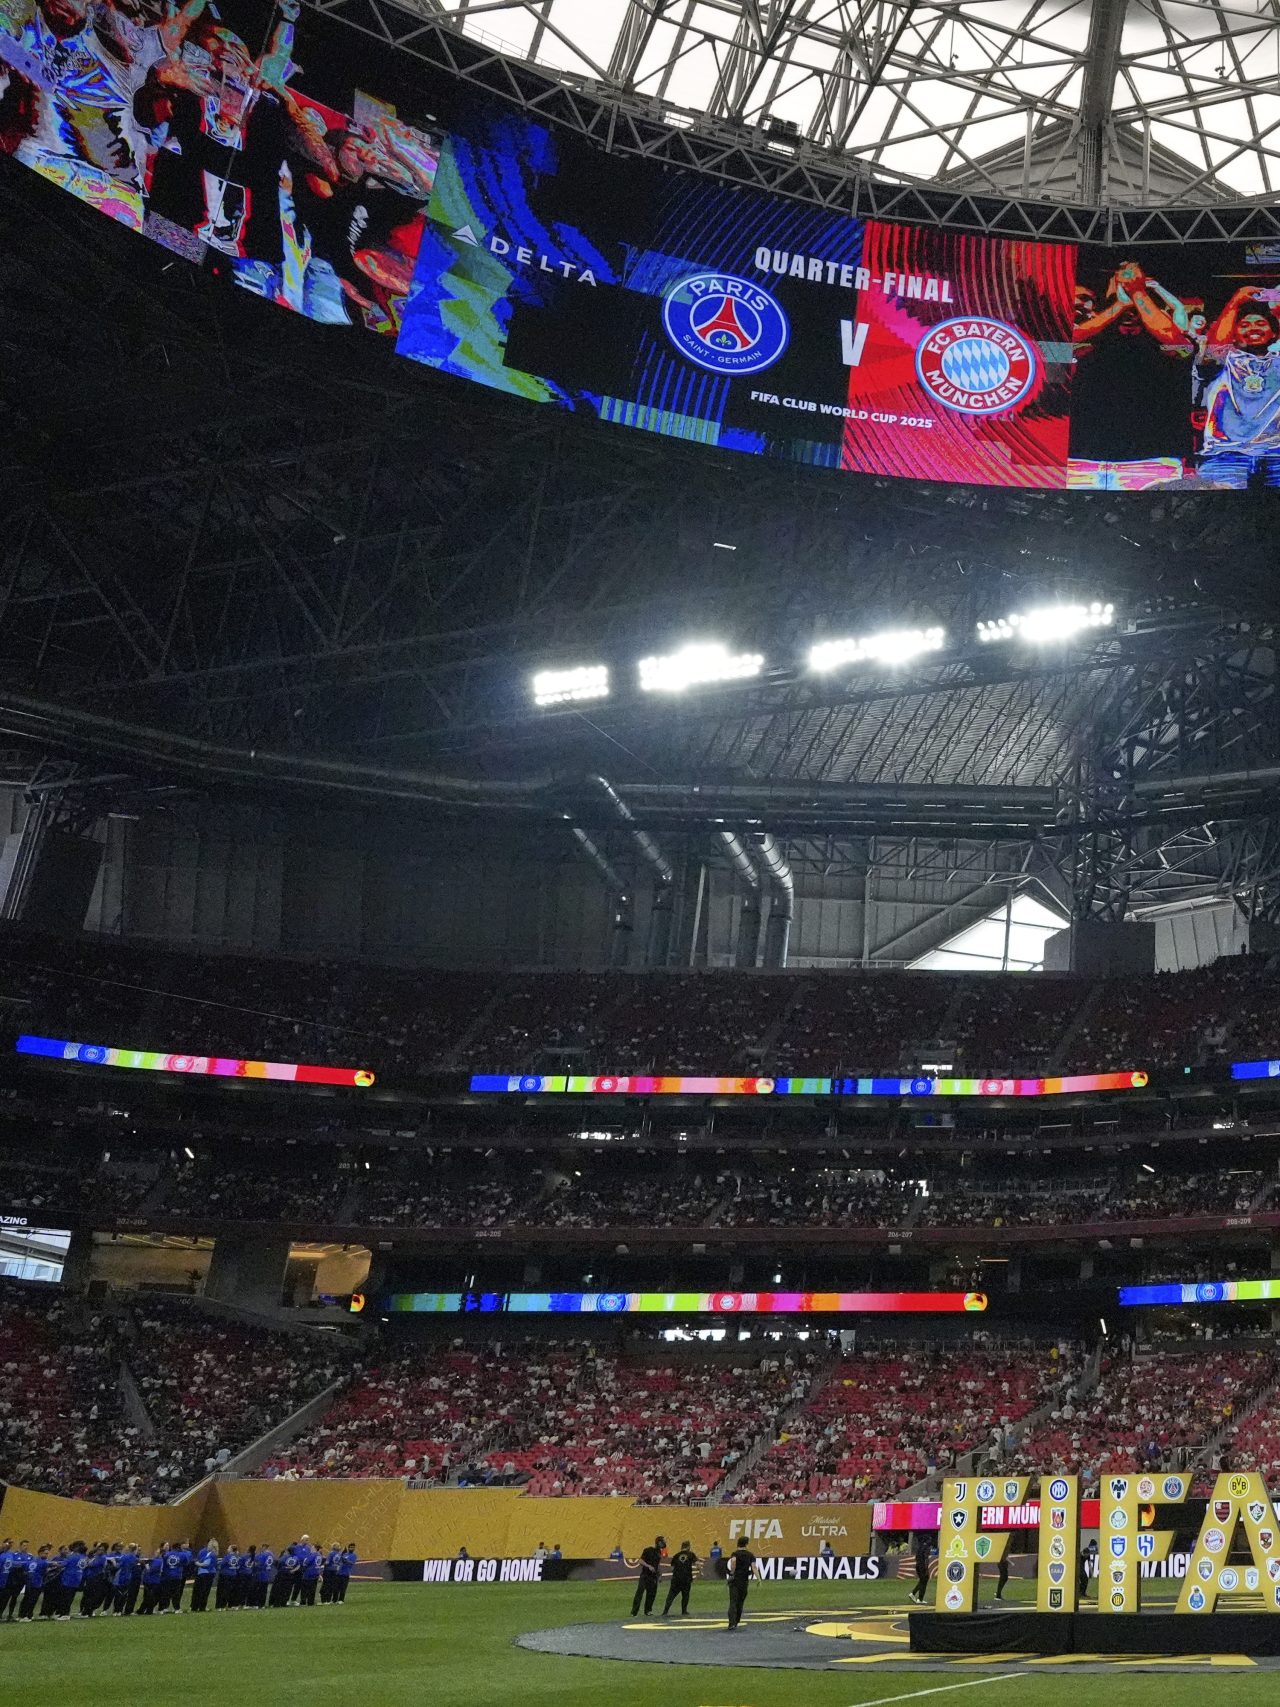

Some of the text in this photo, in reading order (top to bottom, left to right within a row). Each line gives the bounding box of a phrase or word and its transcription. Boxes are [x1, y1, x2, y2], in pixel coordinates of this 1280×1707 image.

[490, 235, 597, 287] DELTA
[754, 246, 954, 304] QUARTER-FINAL
[689, 279, 769, 311] PARIS
[682, 334, 763, 365] SAINT GERMAIN
[840, 319, 870, 367] V
[927, 323, 1026, 362] FC BAYERN
[926, 369, 1024, 408] MÜNCHEN
[750, 390, 934, 429] FIFA CLUB WORLD CUP 2025
[1231, 1477, 1247, 1491] BVB
[728, 1518, 784, 1540] FIFA
[801, 1526, 849, 1537] ULTRA
[423, 1559, 544, 1582] WIN OR GO HOME
[727, 1556, 880, 1580] MI-FINALS
